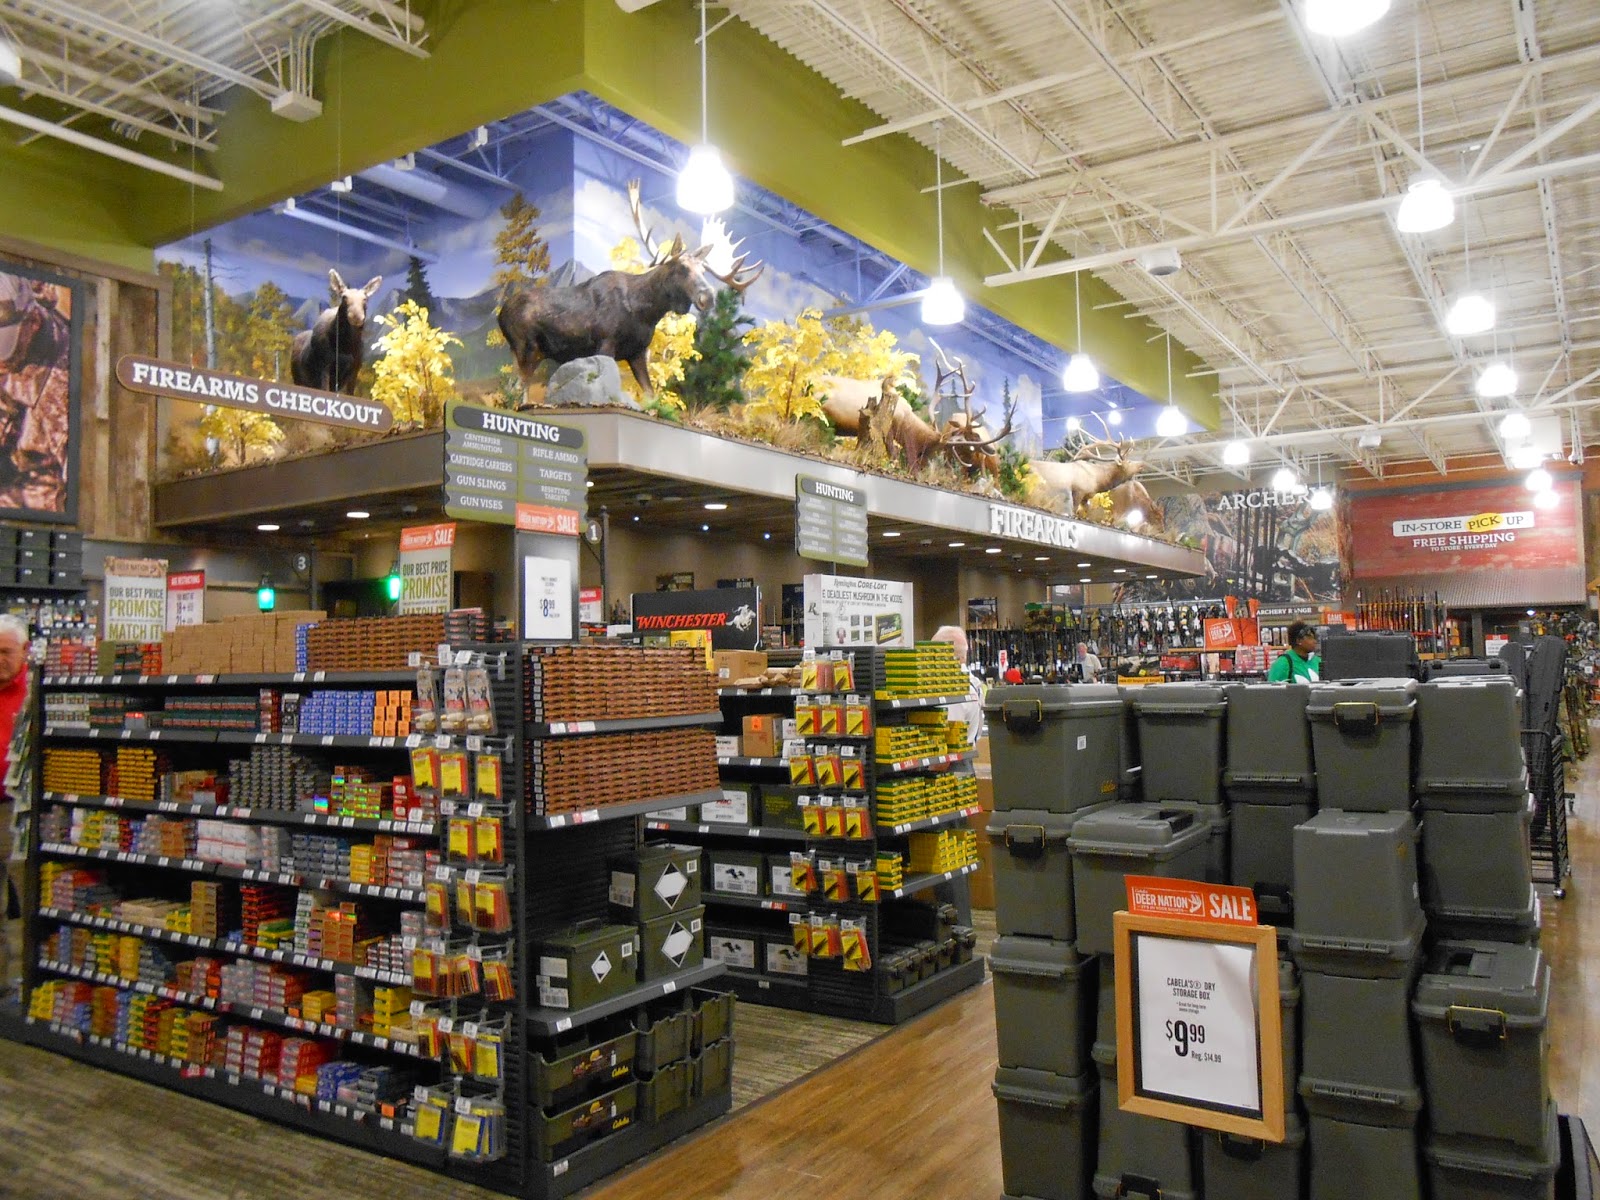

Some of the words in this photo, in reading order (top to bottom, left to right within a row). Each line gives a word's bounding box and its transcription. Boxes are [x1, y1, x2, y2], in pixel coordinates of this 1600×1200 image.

[132, 362, 259, 404] FIREARMS
[265, 388, 382, 425] CHECKOUT
[482, 412, 560, 443] HUNTING
[464, 432, 501, 445] CENTERFIRE
[462, 441, 503, 454] AMMUNITION
[532, 447, 554, 460] RIFLE
[554, 451, 578, 464] AMMO
[450, 453, 484, 468] CARTRIDGE
[484, 459, 513, 473] CARRIERS
[456, 475, 476, 487] GUN
[476, 478, 507, 491] SLINGS
[539, 468, 572, 482] TARGETS
[815, 481, 854, 502] HUNTING
[460, 495, 479, 507] GUN
[479, 498, 503, 510] VISES
[556, 512, 577, 534] SALE
[989, 503, 1078, 549] FIREARMS
[1401, 520, 1462, 533] IN-STORE
[1468, 515, 1500, 530] PICK
[1506, 515, 1524, 526] UP
[434, 528, 453, 546] SALE
[590, 524, 598, 540] 1
[1413, 537, 1446, 548] FREE
[1449, 532, 1515, 546] SHIPPING
[1464, 543, 1485, 551] EVERY
[298, 556, 306, 570] 3
[404, 563, 414, 576] OUR
[415, 562, 430, 576] BEST
[430, 560, 448, 575] PRICE
[109, 587, 124, 598] OUR
[125, 588, 143, 599] BEST
[144, 588, 164, 599] PRICE
[402, 574, 448, 600] PROMISE
[827, 590, 852, 600] DEADLIEST
[853, 593, 876, 601] MUSHROOM
[876, 594, 880, 602] IN
[881, 594, 889, 603] THE
[109, 599, 164, 618] PROMISE
[1256, 608, 1287, 616] ARCHERY
[635, 612, 727, 630] WINCHESTER
[1327, 613, 1342, 621] GAME
[109, 623, 147, 640] MATCH
[1135, 893, 1157, 906] DEER
[1157, 895, 1188, 908] NATION
[1209, 893, 1253, 921] SALE
[1172, 987, 1198, 999] STORAGE
[1198, 991, 1210, 1001] BOX
[1204, 981, 1216, 992] DRY
[1191, 1050, 1203, 1062] Reg.
[1204, 1052, 1222, 1063] $14.99
